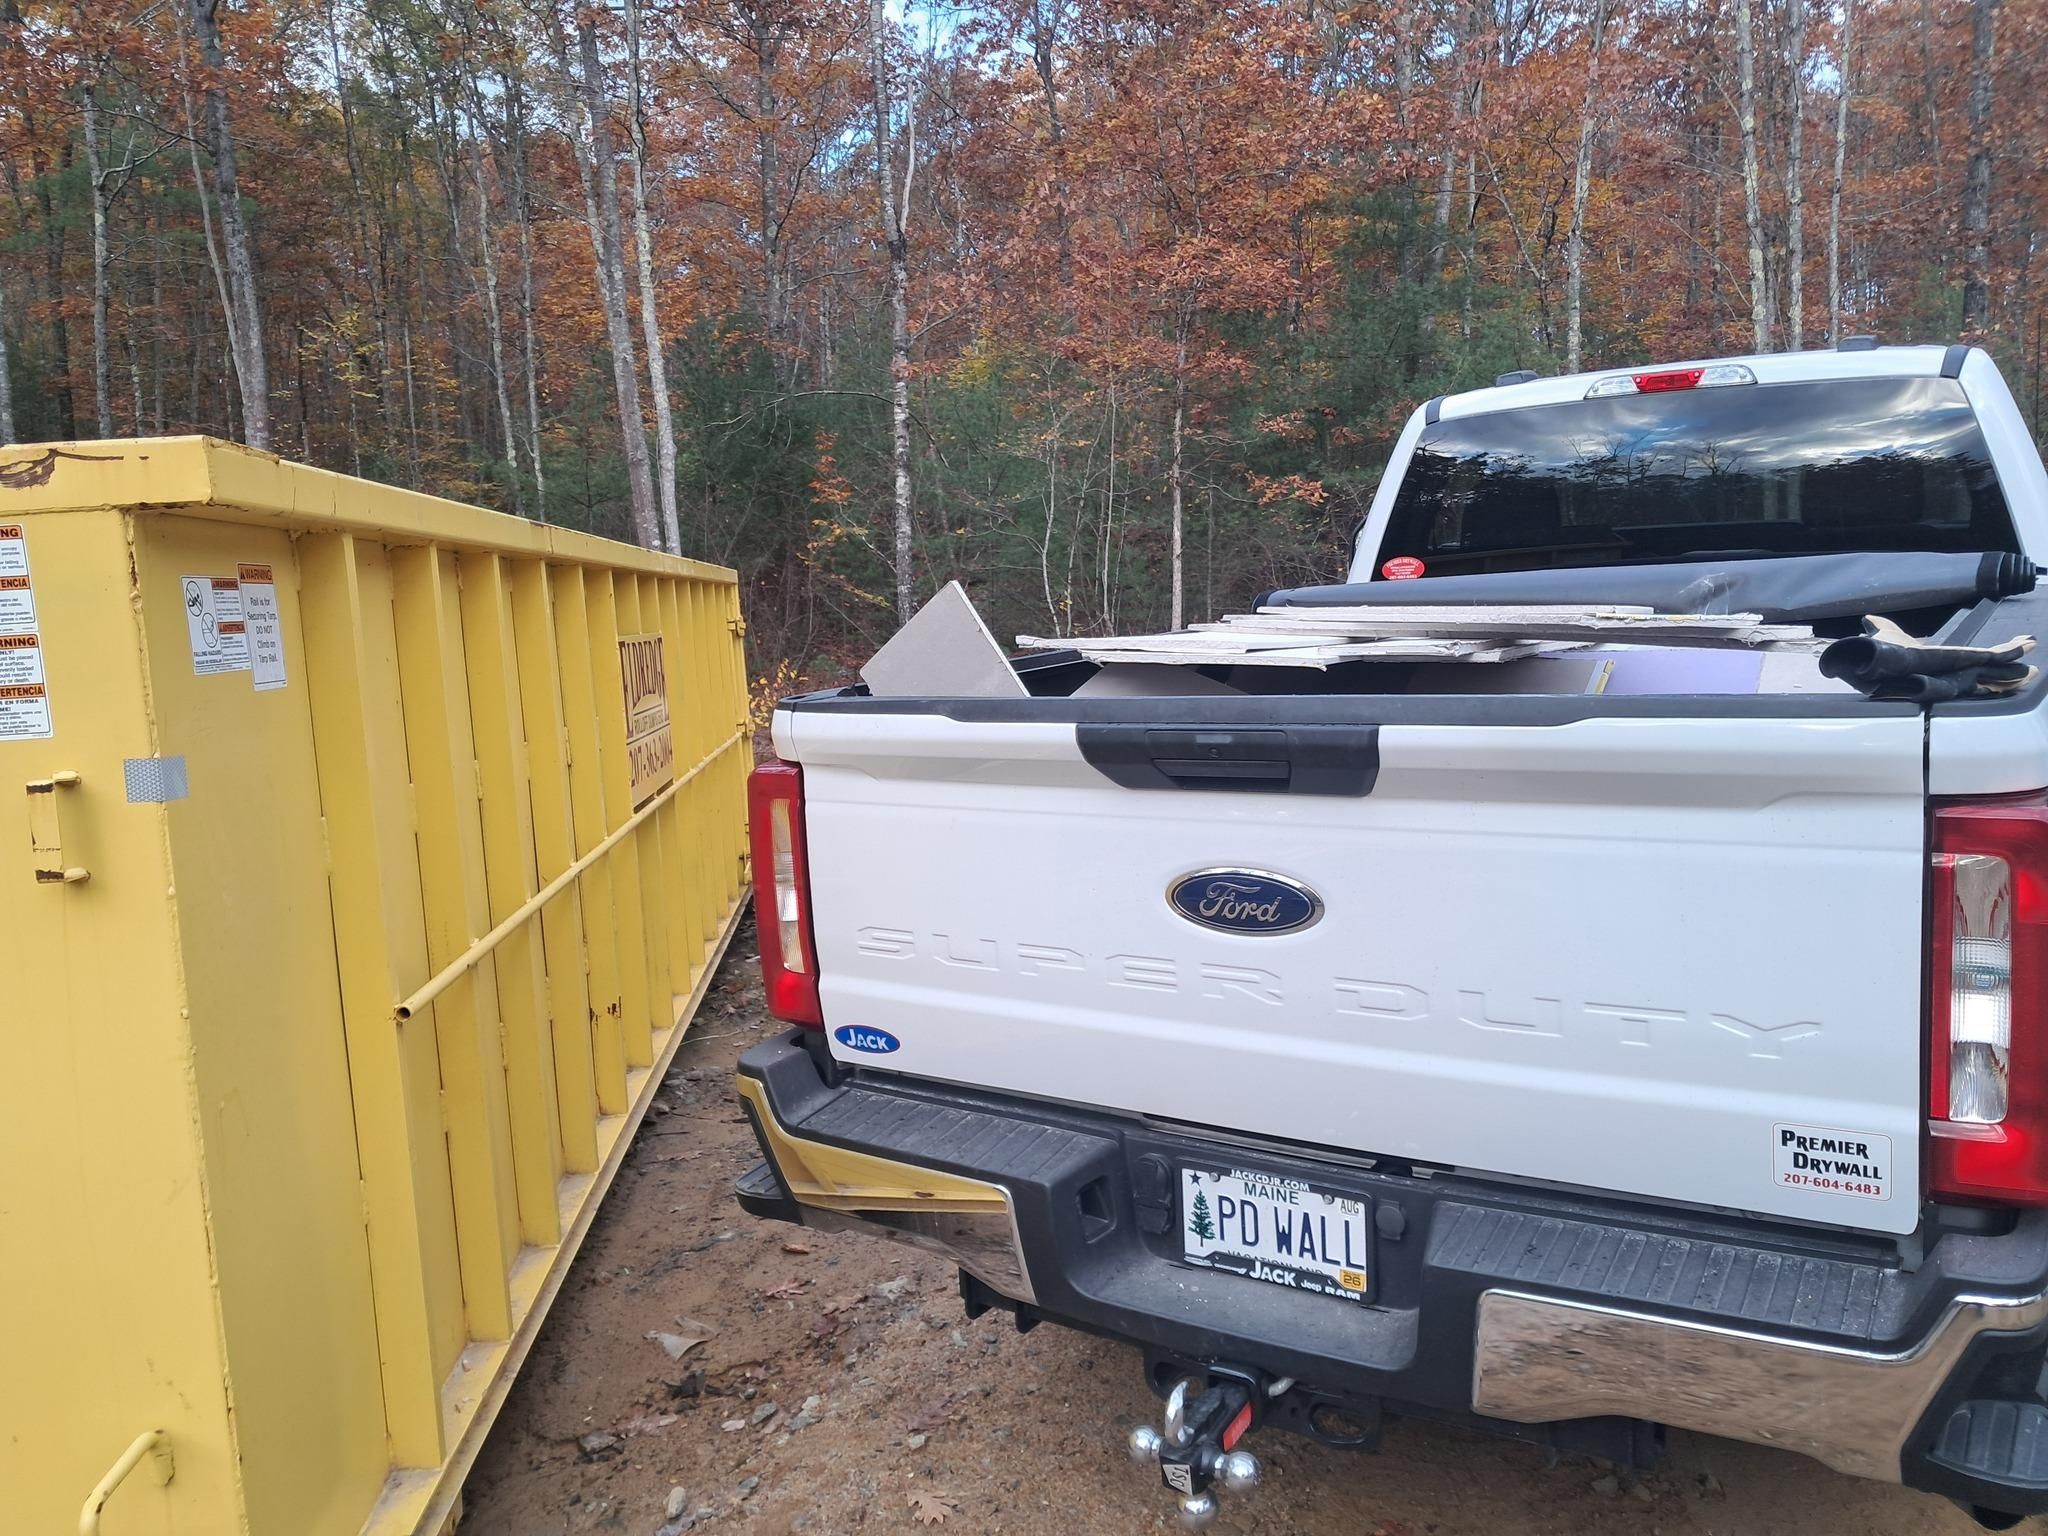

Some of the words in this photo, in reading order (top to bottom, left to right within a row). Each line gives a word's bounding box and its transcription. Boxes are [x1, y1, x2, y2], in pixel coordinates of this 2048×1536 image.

[247, 611, 266, 622] Securing
[256, 626, 263, 634] DO
[264, 625, 273, 634] NOT
[257, 640, 270, 649] Climb
[0, 686, 43, 698] ERTENCIA
[1200, 881, 1281, 924] Ford
[857, 926, 1284, 1006] SUPER
[1334, 976, 1822, 1059] DUTY
[846, 1028, 889, 1051] JACK
[1781, 1129, 1869, 1159] PREMIER
[1793, 1152, 1883, 1180] DRYWALL
[1229, 1169, 1311, 1192] JACKCDJR.COM
[1783, 1173, 1882, 1196] 207-604-6483
[1243, 1182, 1300, 1205] MAINE
[1339, 1200, 1360, 1214] AUG
[1217, 1194, 1260, 1247] PD
[1274, 1206, 1365, 1270] WALL
[1249, 1260, 1297, 1287] JACK
[1300, 1279, 1322, 1292] Jeep
[1324, 1286, 1361, 1300] RAM
[1342, 1275, 1361, 1287] 26
